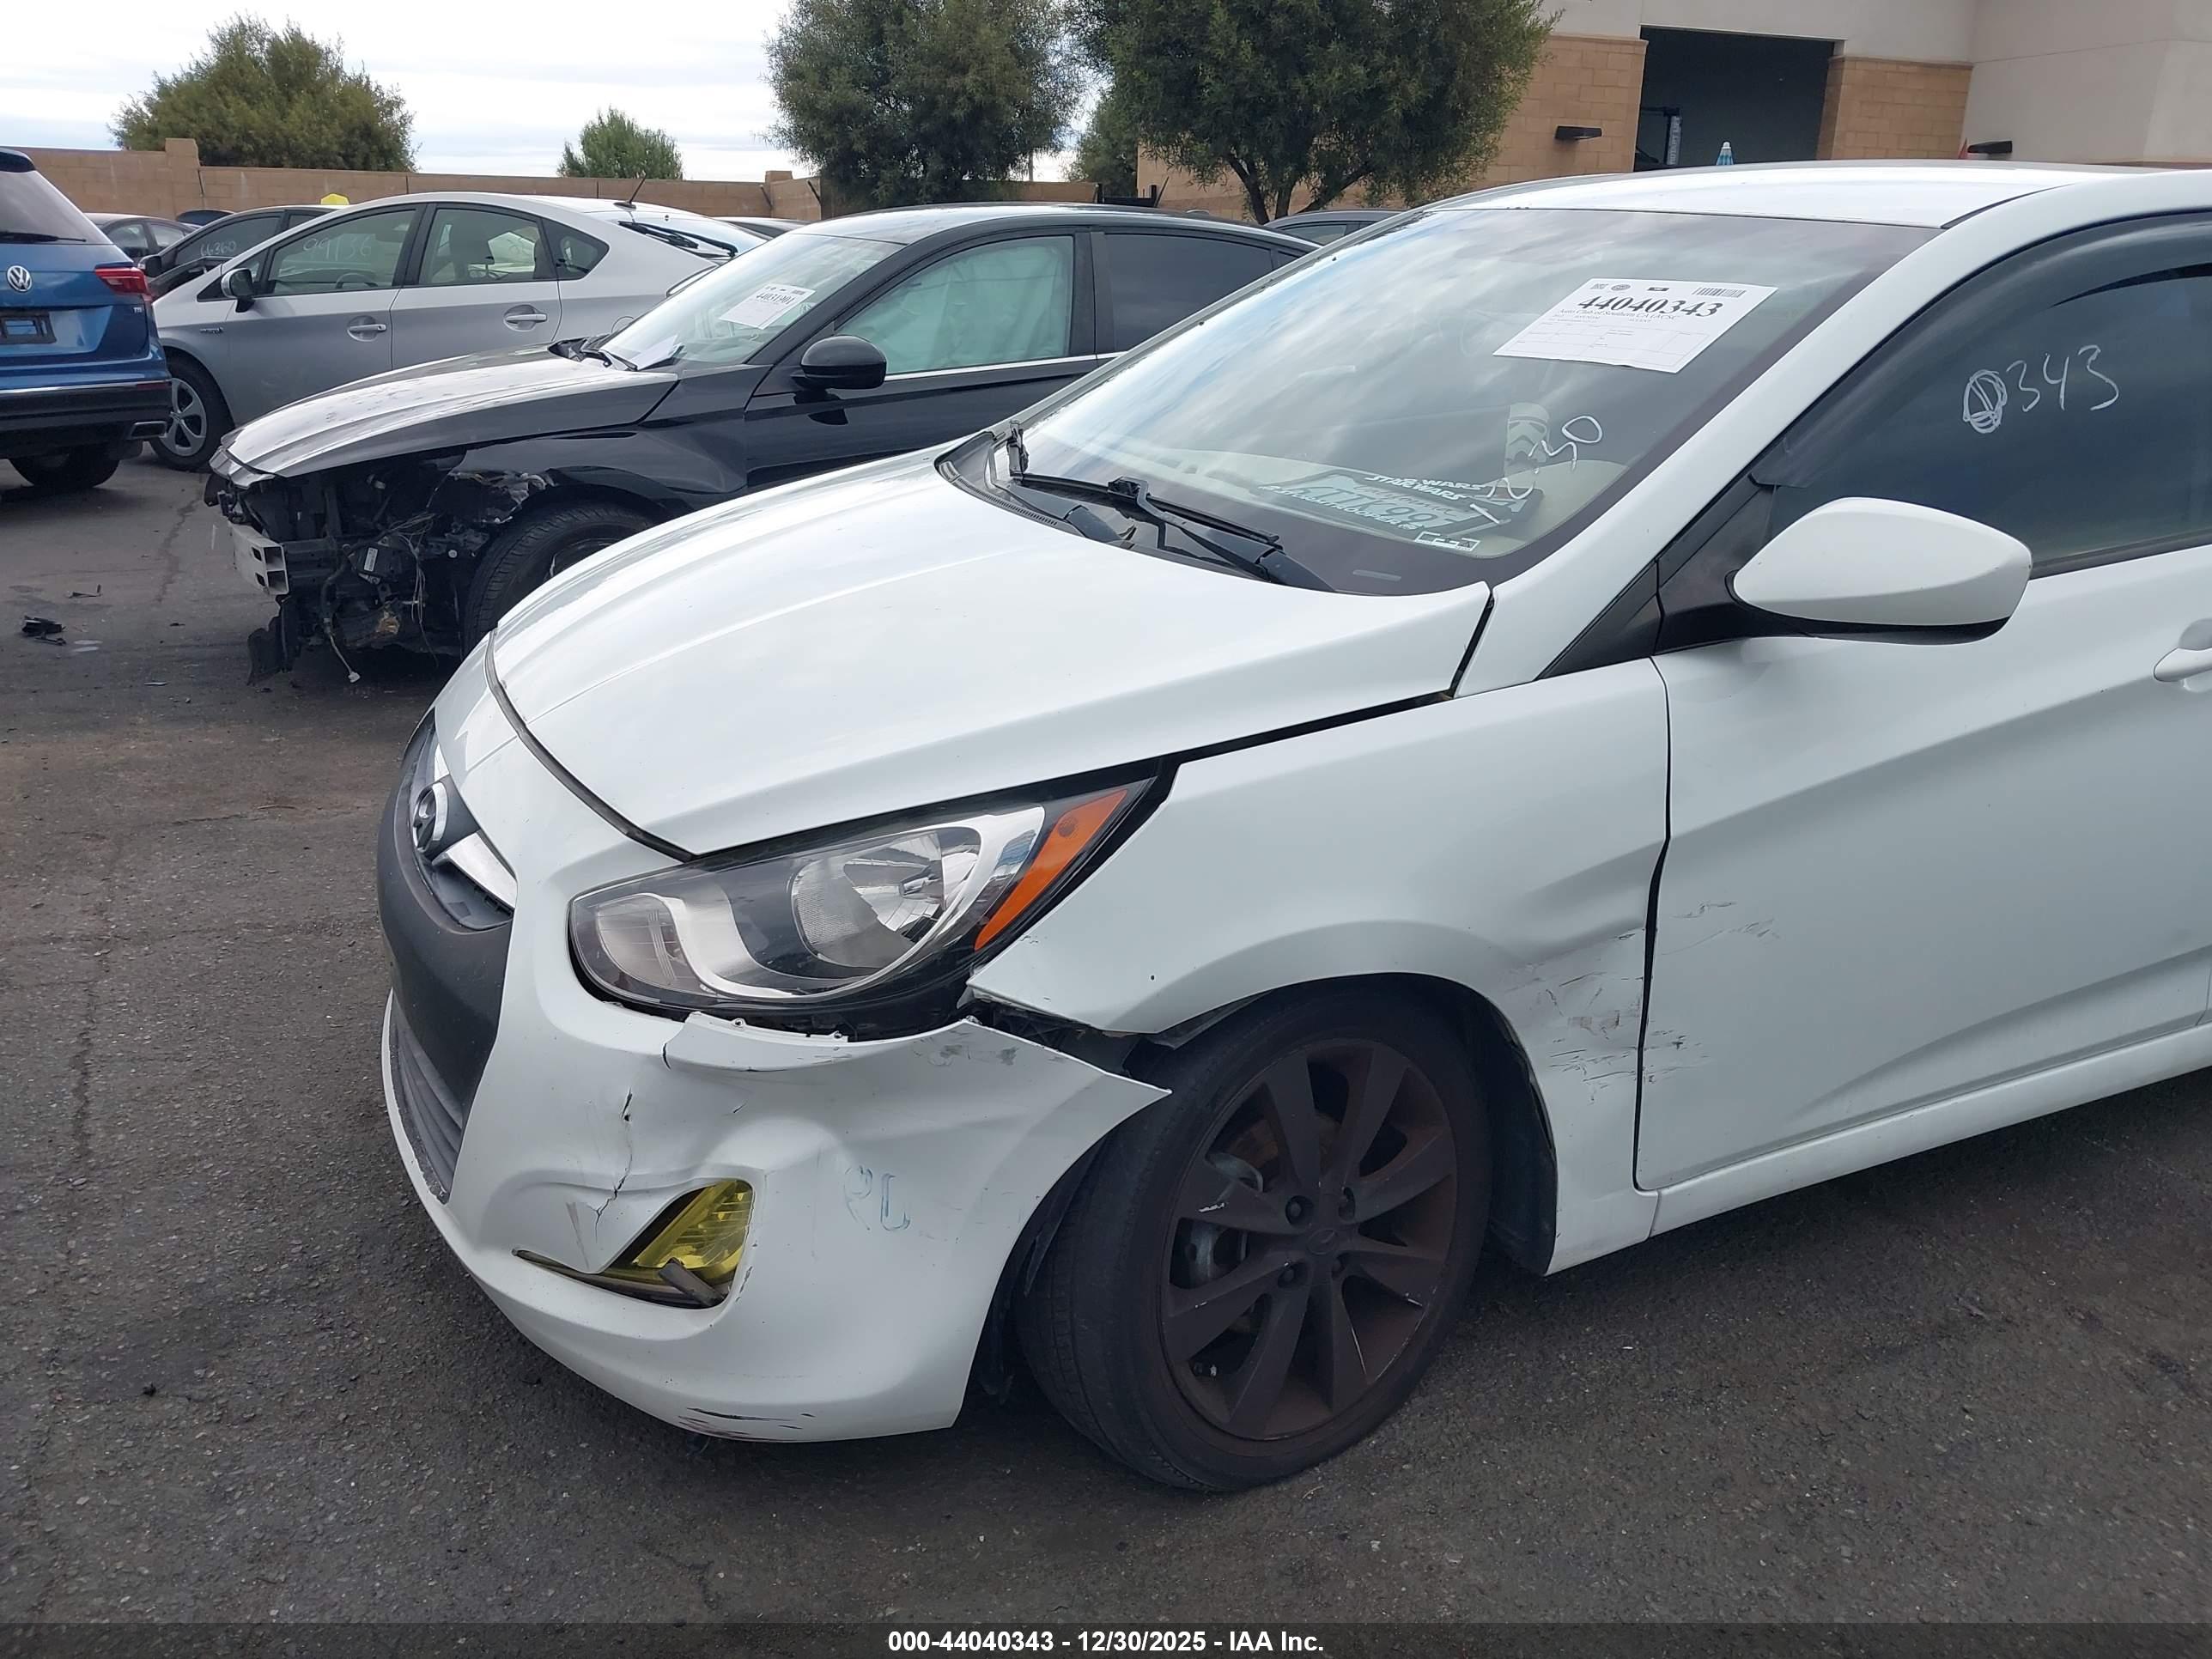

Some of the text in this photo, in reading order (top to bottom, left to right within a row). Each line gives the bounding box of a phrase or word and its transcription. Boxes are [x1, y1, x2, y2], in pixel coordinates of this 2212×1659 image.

[1577, 295, 1723, 317] 44040343
[1364, 475, 1468, 501] STAR WARS
